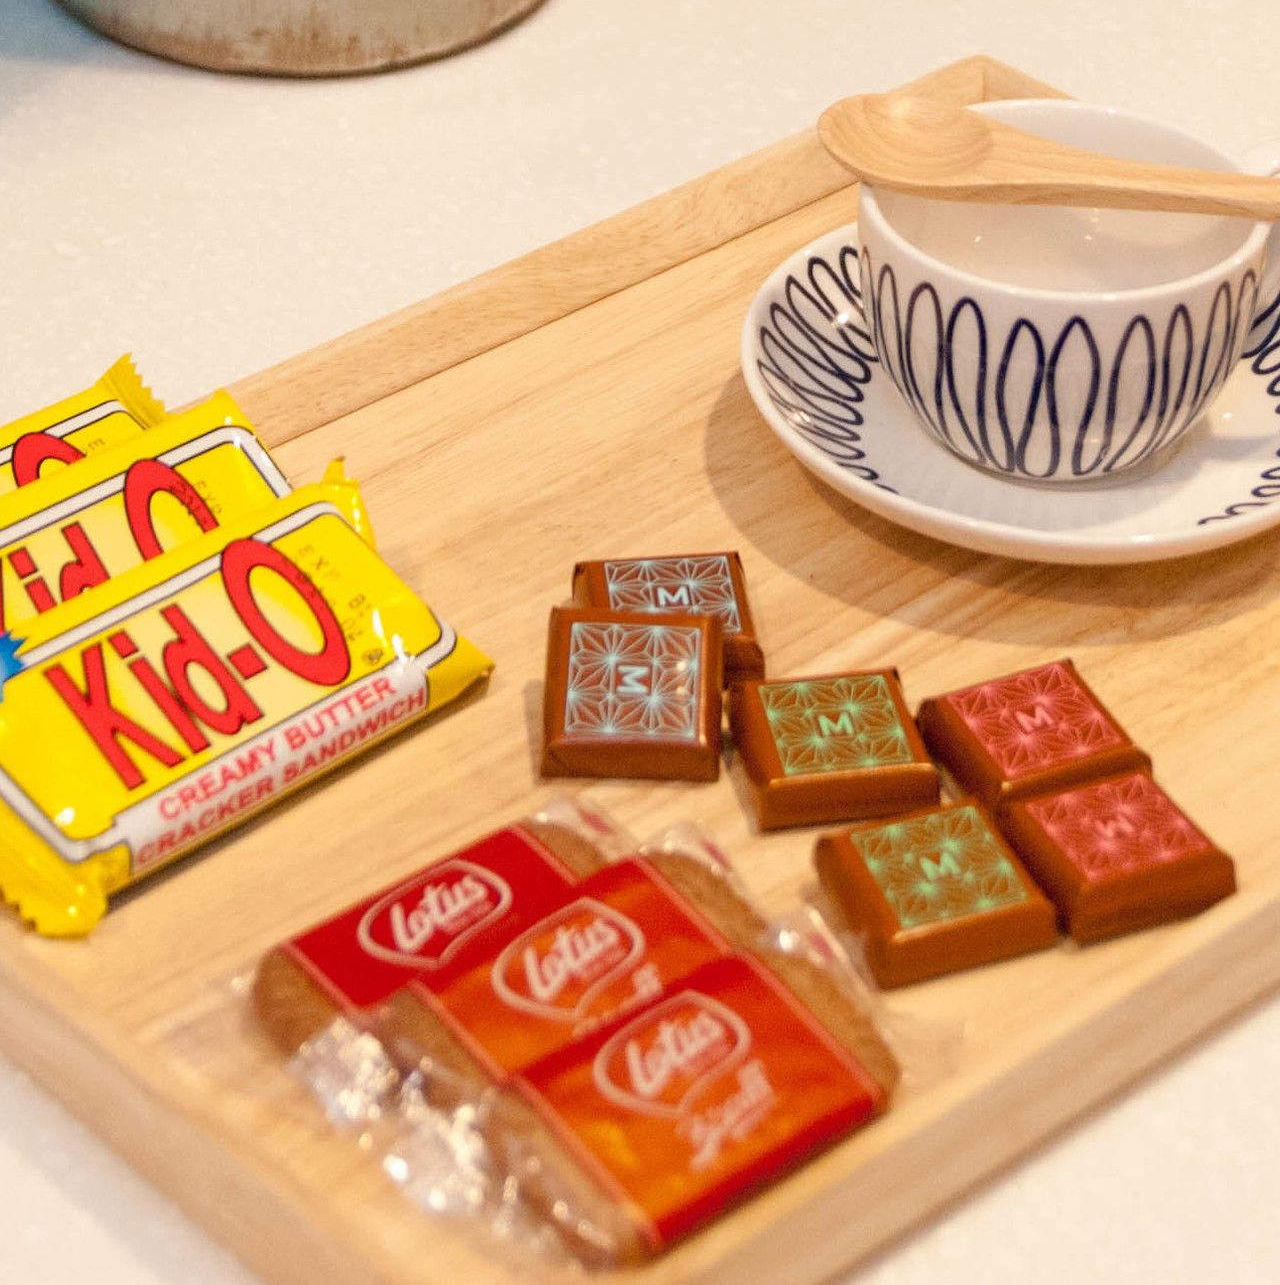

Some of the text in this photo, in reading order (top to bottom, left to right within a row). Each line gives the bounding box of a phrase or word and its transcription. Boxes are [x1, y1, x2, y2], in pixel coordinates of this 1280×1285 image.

[657, 585, 690, 607] M
[43, 537, 351, 791] Kid-O
[158, 676, 397, 821] CREAMY BUTTER
[818, 711, 855, 736] M
[1015, 705, 1054, 733] M
[136, 687, 426, 867] CRACKER SANDWICH
[920, 852, 961, 881] M
[390, 873, 489, 954] Lotus
[523, 916, 619, 1001] Lotus
[625, 1009, 725, 1097] Lotus
